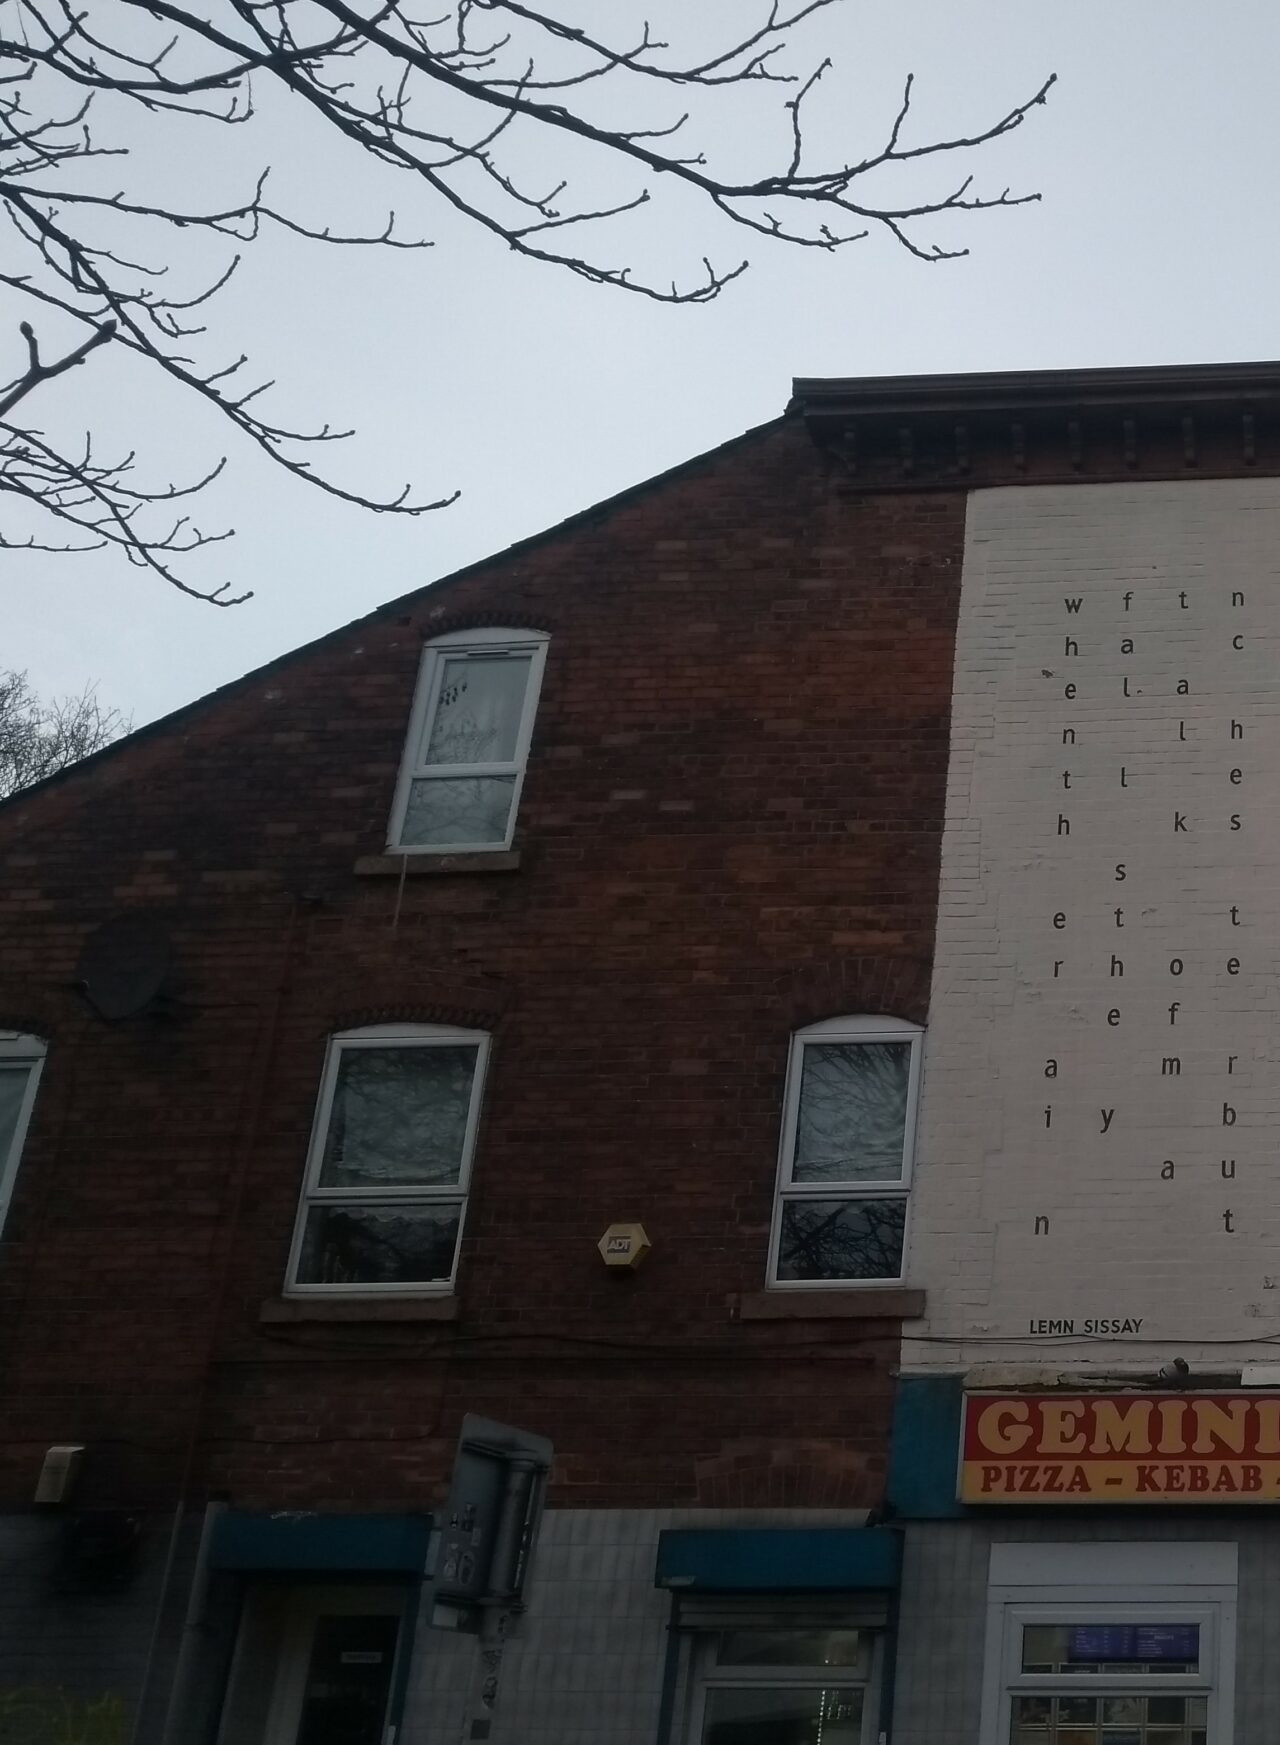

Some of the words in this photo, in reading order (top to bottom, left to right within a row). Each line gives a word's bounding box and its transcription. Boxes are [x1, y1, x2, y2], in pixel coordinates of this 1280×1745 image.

[1064, 598, 1084, 613] w
[1122, 591, 1134, 611] f
[1178, 591, 1189, 609] t
[1232, 591, 1245, 606] n
[1065, 636, 1079, 656] h
[1120, 638, 1134, 654] a
[1232, 634, 1244, 649] c
[1064, 683, 1077, 699] e
[1176, 679, 1189, 695] a
[1062, 728, 1076, 744] n
[1231, 719, 1243, 739] h
[1062, 770, 1072, 789] t
[1229, 768, 1243, 784] e
[1057, 813, 1070, 835] h
[1174, 811, 1188, 832] k
[1230, 814, 1241, 830] s
[1115, 863, 1127, 881] s
[1053, 912, 1066, 929] e
[1113, 907, 1125, 927] t
[1229, 905, 1241, 926] t
[1053, 960, 1065, 977] r
[1110, 954, 1124, 976] h
[1169, 958, 1184, 975] o
[1226, 957, 1241, 975] e
[1107, 1008, 1121, 1026] e
[1168, 1002, 1181, 1024] f
[1044, 1059, 1058, 1077] a
[1161, 1057, 1181, 1075] m
[1228, 1055, 1238, 1074] r
[1044, 1104, 1052, 1128] i
[1100, 1108, 1115, 1133] y
[1222, 1102, 1237, 1126] b
[1160, 1160, 1175, 1179] a
[1221, 1159, 1236, 1178] u
[1034, 1215, 1050, 1235] n
[1222, 1208, 1235, 1233] t
[608, 1239, 631, 1250] ADT
[1029, 1319, 1074, 1335] LEMN
[1084, 1318, 1144, 1335] SISSAY
[981, 1465, 1092, 1492] PIZZA
[1135, 1465, 1263, 1492] KEBAB
